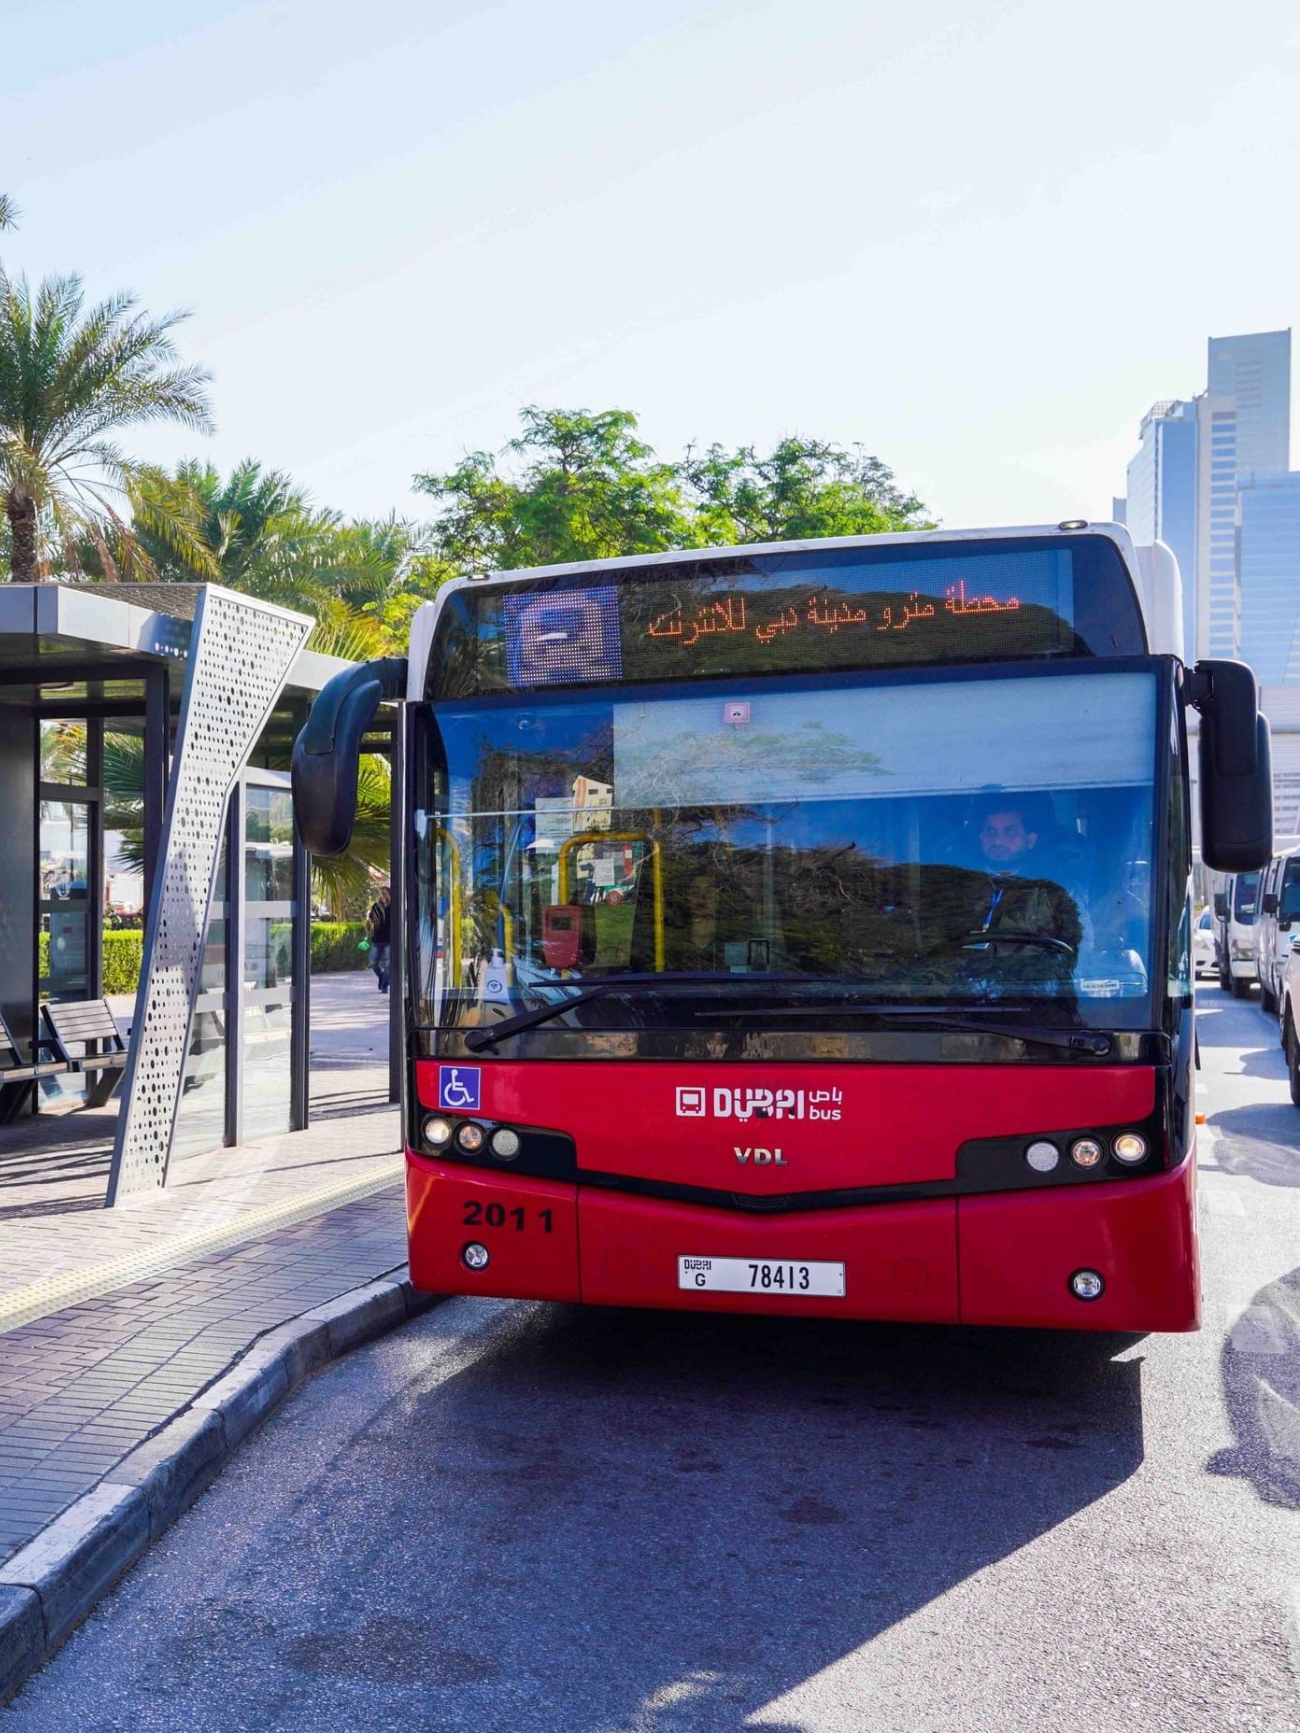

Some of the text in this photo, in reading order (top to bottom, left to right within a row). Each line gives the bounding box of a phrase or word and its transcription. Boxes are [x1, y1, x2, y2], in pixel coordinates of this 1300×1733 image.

[877, 592, 935, 630] مترو
[945, 579, 1019, 614] محطة
[756, 607, 798, 644] دبي
[808, 596, 867, 634] مدينة
[808, 1087, 842, 1105] باص
[809, 1106, 842, 1121] bus
[733, 1146, 788, 1165] VDL
[462, 1201, 552, 1233] 2011
[695, 1264, 810, 1290] G 78413
